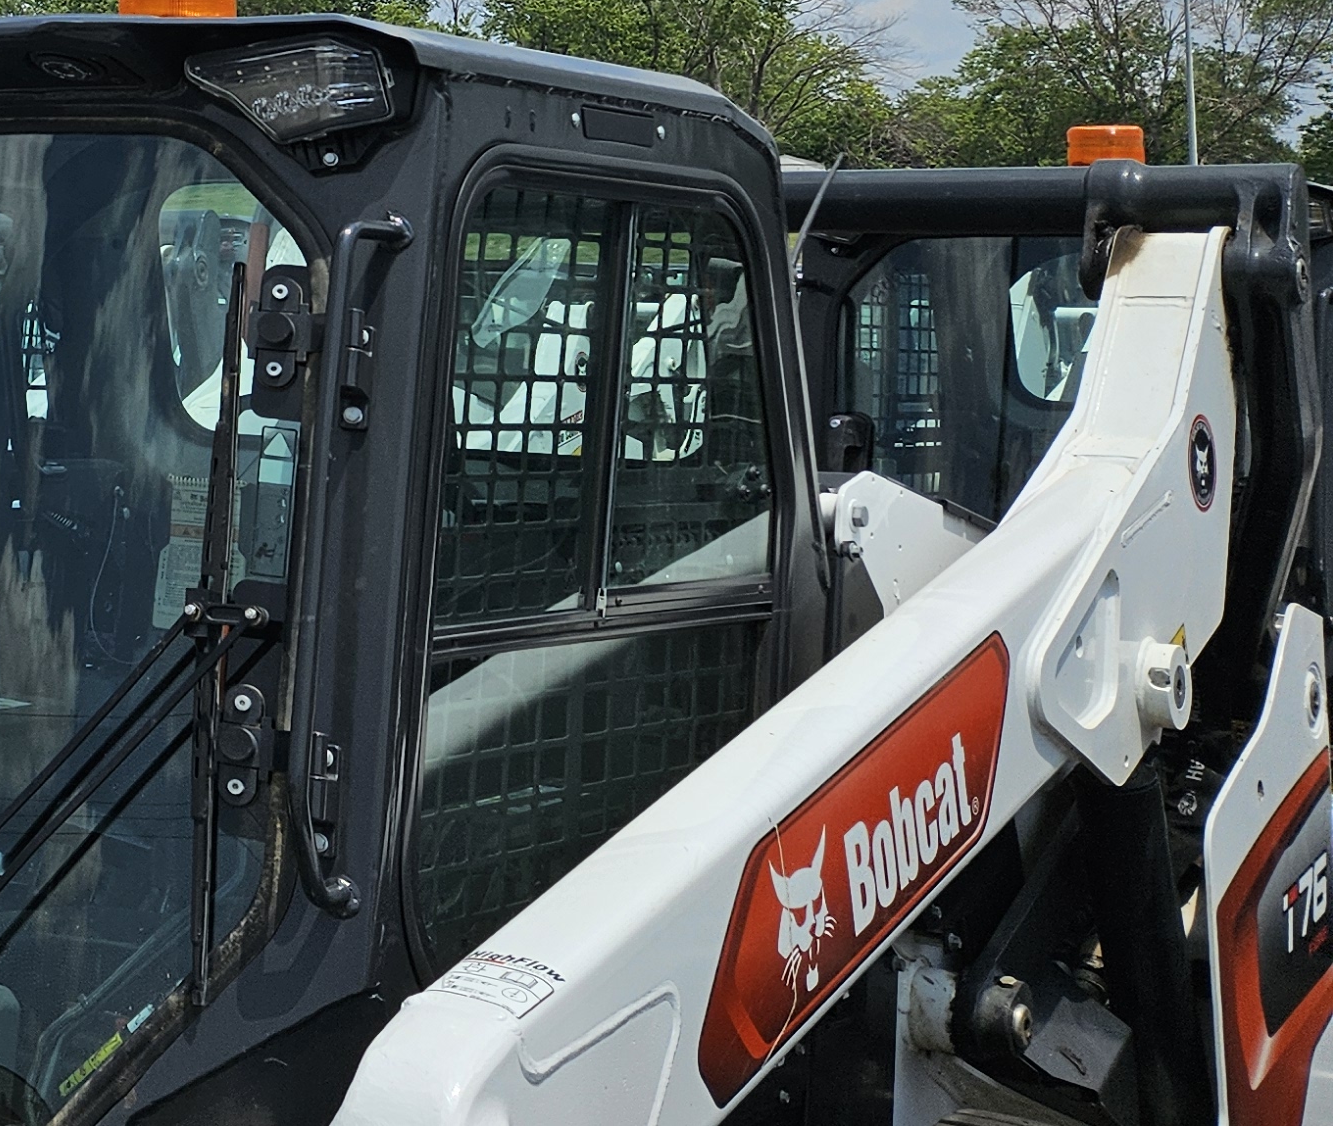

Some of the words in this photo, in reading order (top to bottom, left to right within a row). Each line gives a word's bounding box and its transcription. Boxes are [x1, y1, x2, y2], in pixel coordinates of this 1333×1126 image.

[843, 731, 972, 938] Bobcat
[1282, 851, 1328, 954] T76
[472, 949, 566, 983] HighFlow
